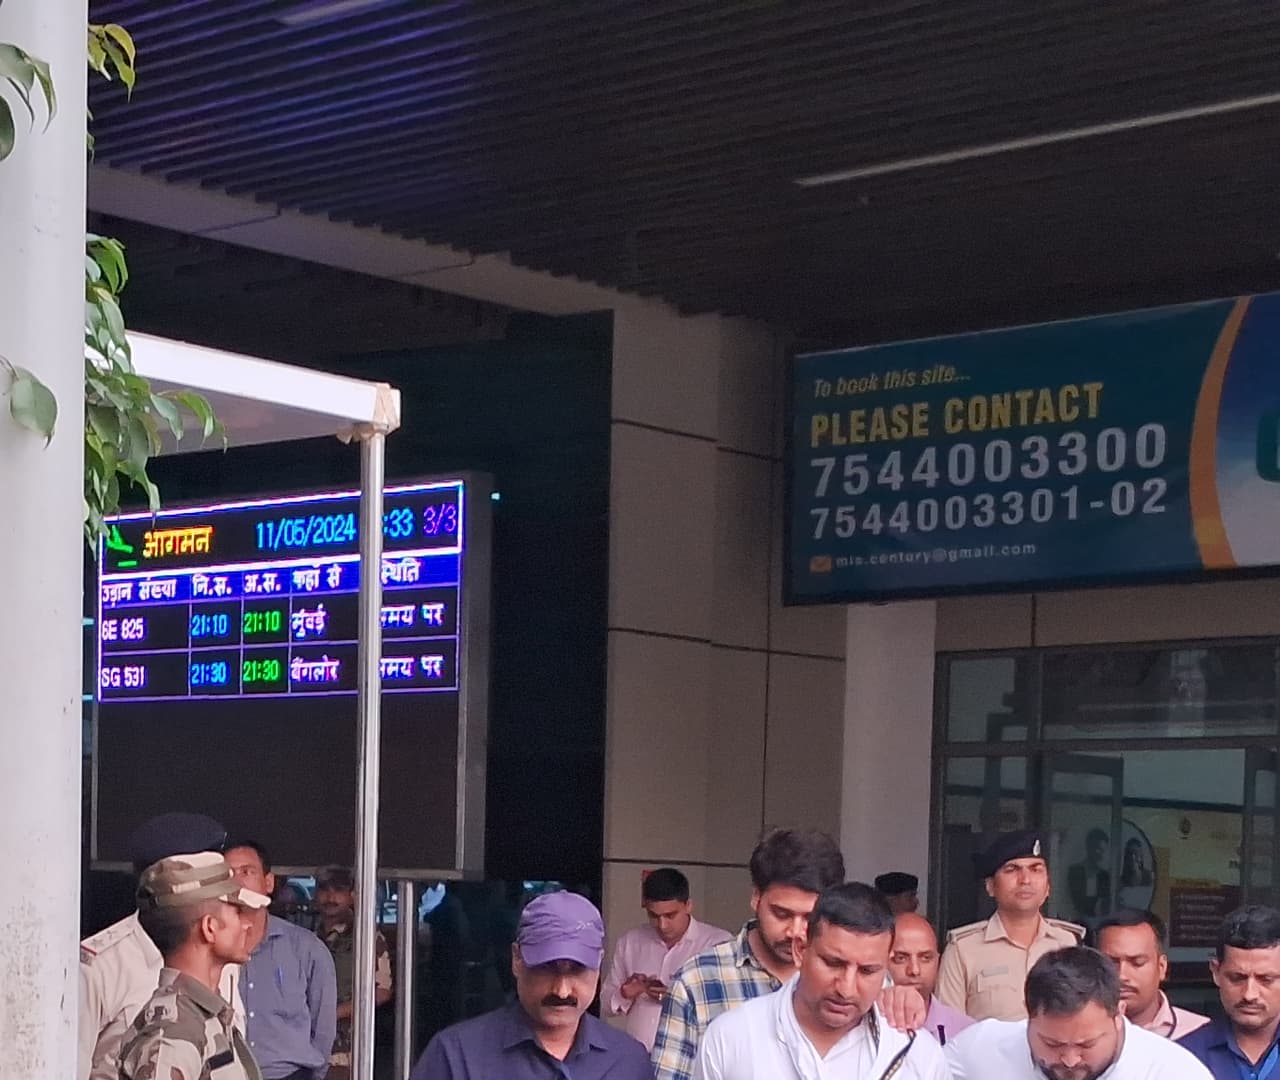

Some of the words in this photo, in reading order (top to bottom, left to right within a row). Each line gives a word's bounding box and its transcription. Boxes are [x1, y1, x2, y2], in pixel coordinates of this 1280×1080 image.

[815, 379, 832, 398] To
[836, 374, 878, 395] book
[884, 368, 916, 390] this
[811, 401, 929, 448] PLEASE
[944, 381, 1104, 434] CONTACT
[810, 423, 1167, 497] 7544003300
[257, 513, 356, 551] 11/05/2024
[423, 503, 457, 535] 3/3
[809, 478, 1168, 539] 7544003301-02
[143, 527, 213, 558] आगमन
[326, 563, 342, 588] से
[102, 619, 118, 640] 6E
[121, 617, 144, 640] 825
[191, 614, 227, 636] 21:10
[243, 611, 280, 633] 21:10
[291, 603, 326, 638] मुंबई
[422, 602, 444, 626] पर
[101, 667, 121, 687] SG
[124, 665, 145, 687] 531
[191, 661, 227, 684] 21:30
[243, 659, 279, 682] 21:30
[421, 655, 444, 677] पर
